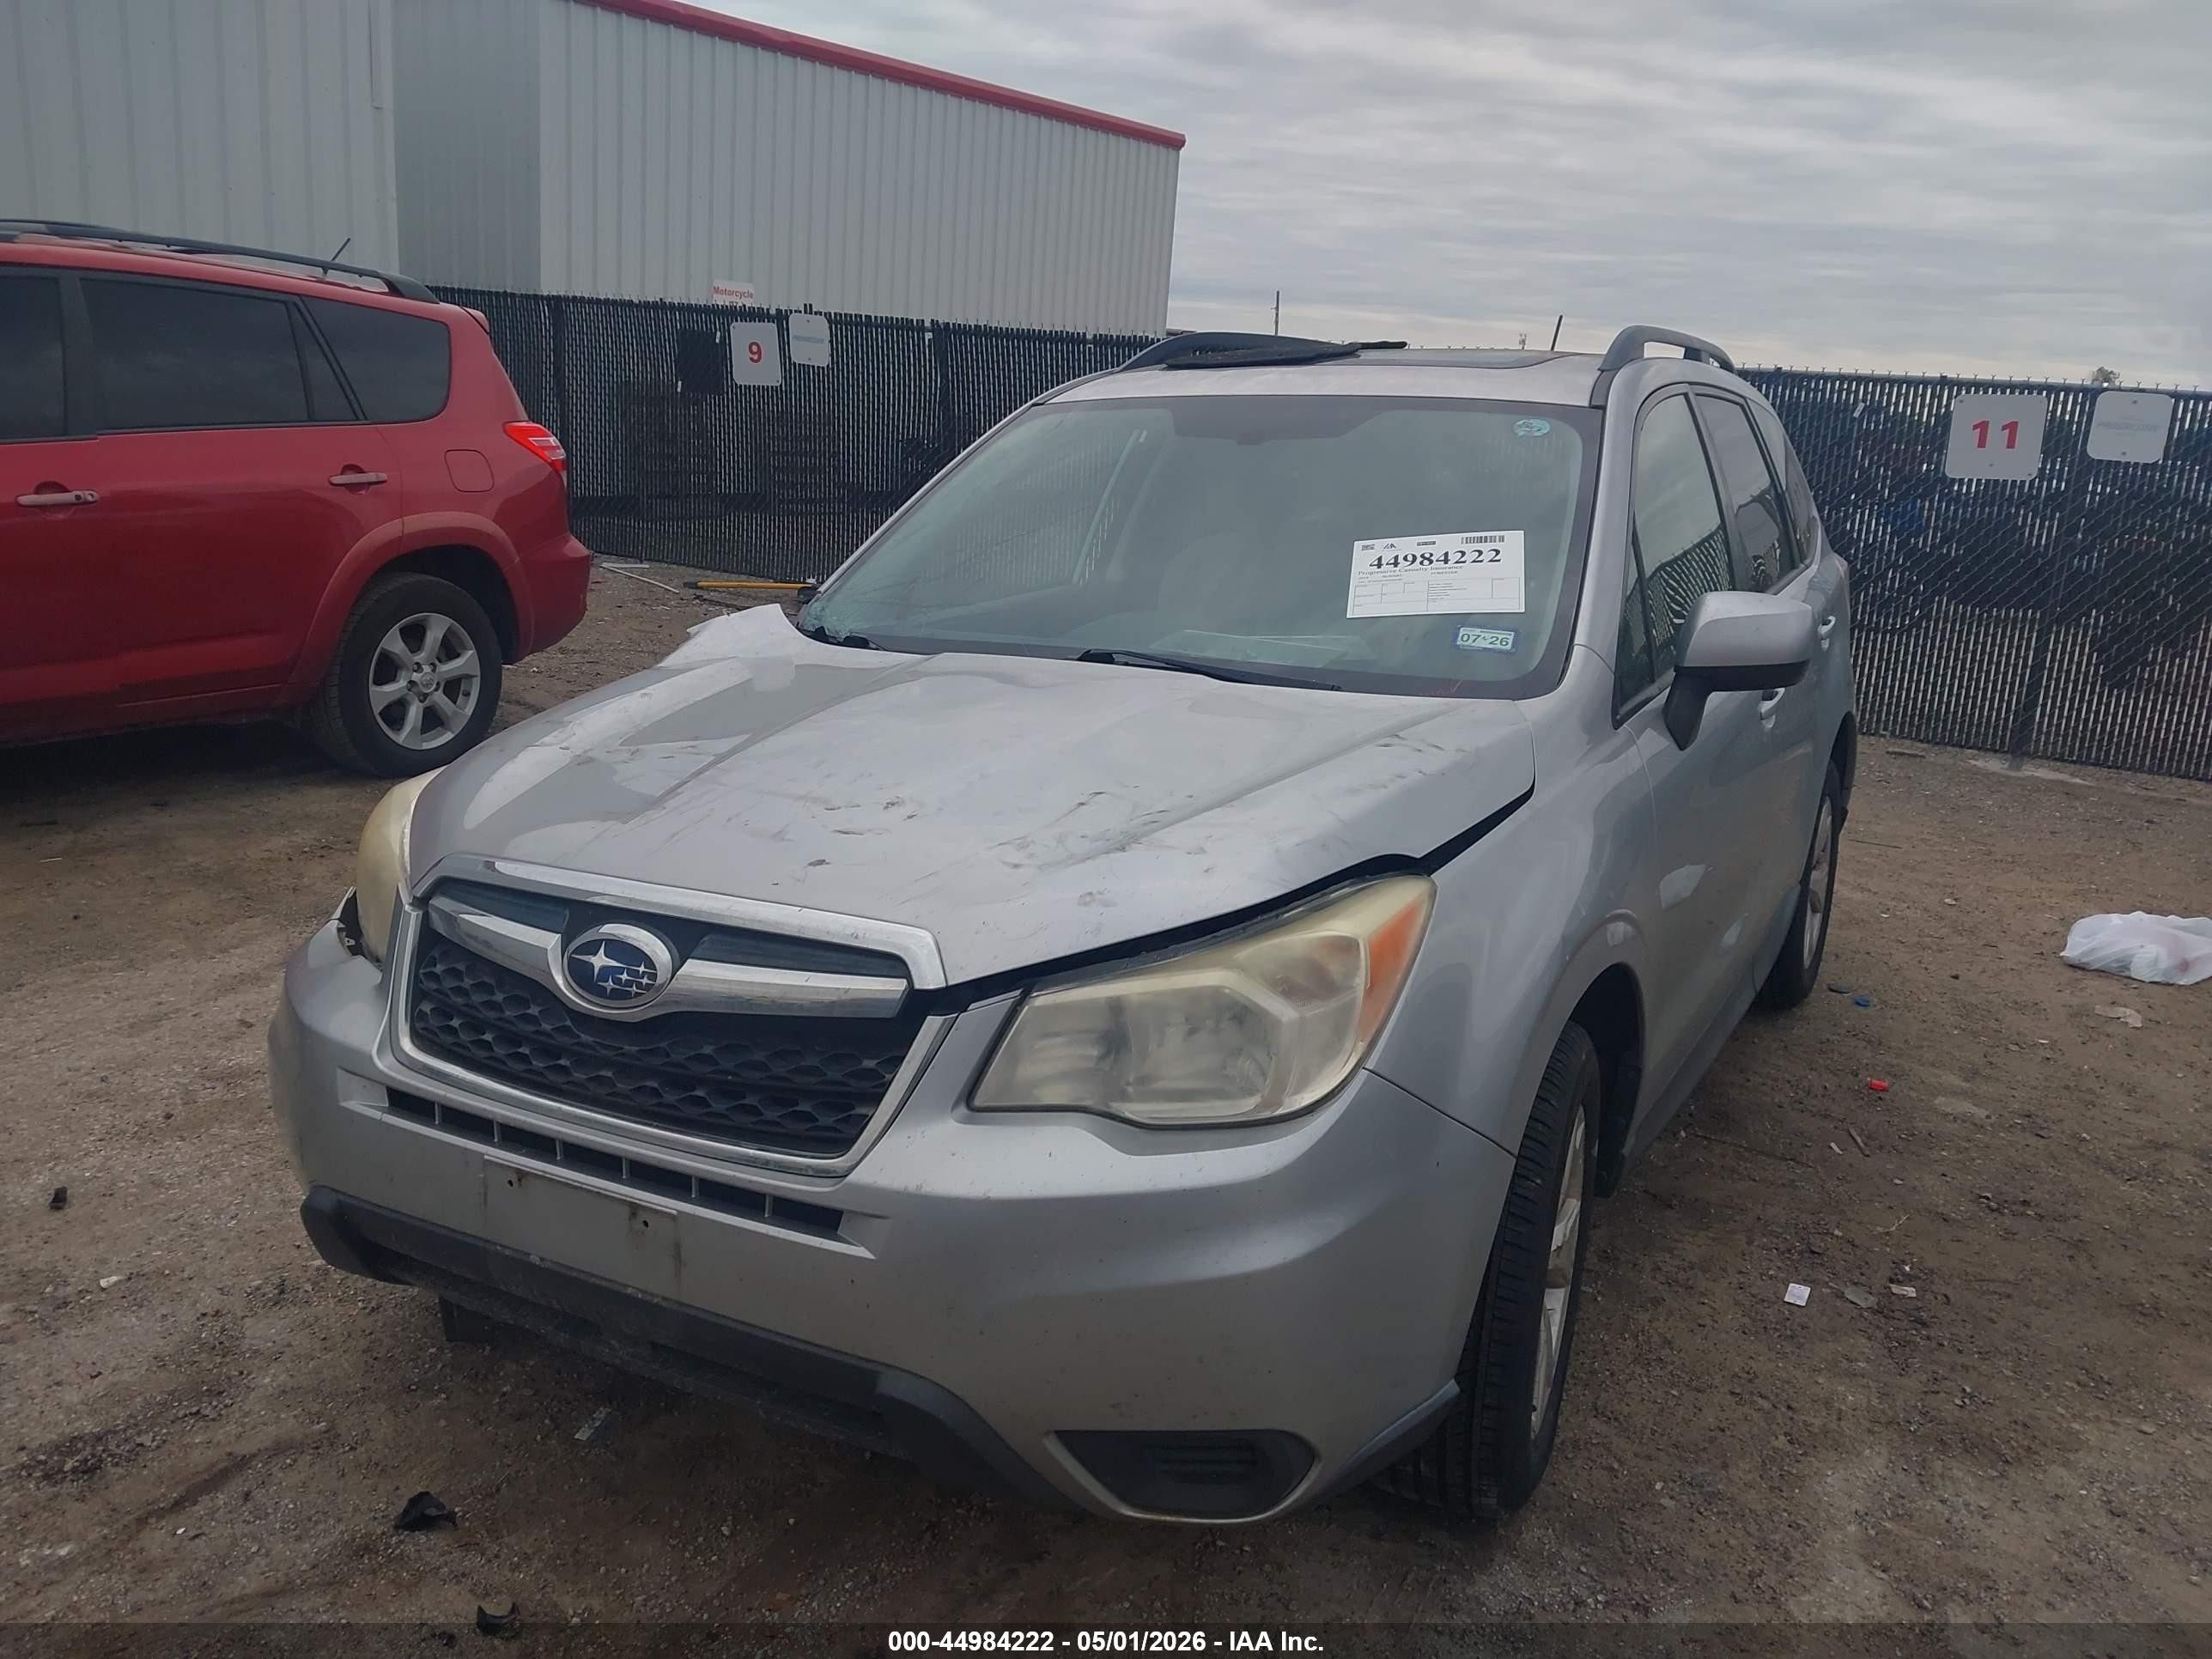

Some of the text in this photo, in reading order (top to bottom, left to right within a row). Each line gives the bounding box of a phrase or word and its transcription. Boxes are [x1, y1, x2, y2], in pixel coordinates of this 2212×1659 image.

[714, 286, 754, 299] Motorcycle
[748, 341, 763, 363] 9
[1972, 420, 2019, 449] 11
[1369, 549, 1502, 568] 44984222
